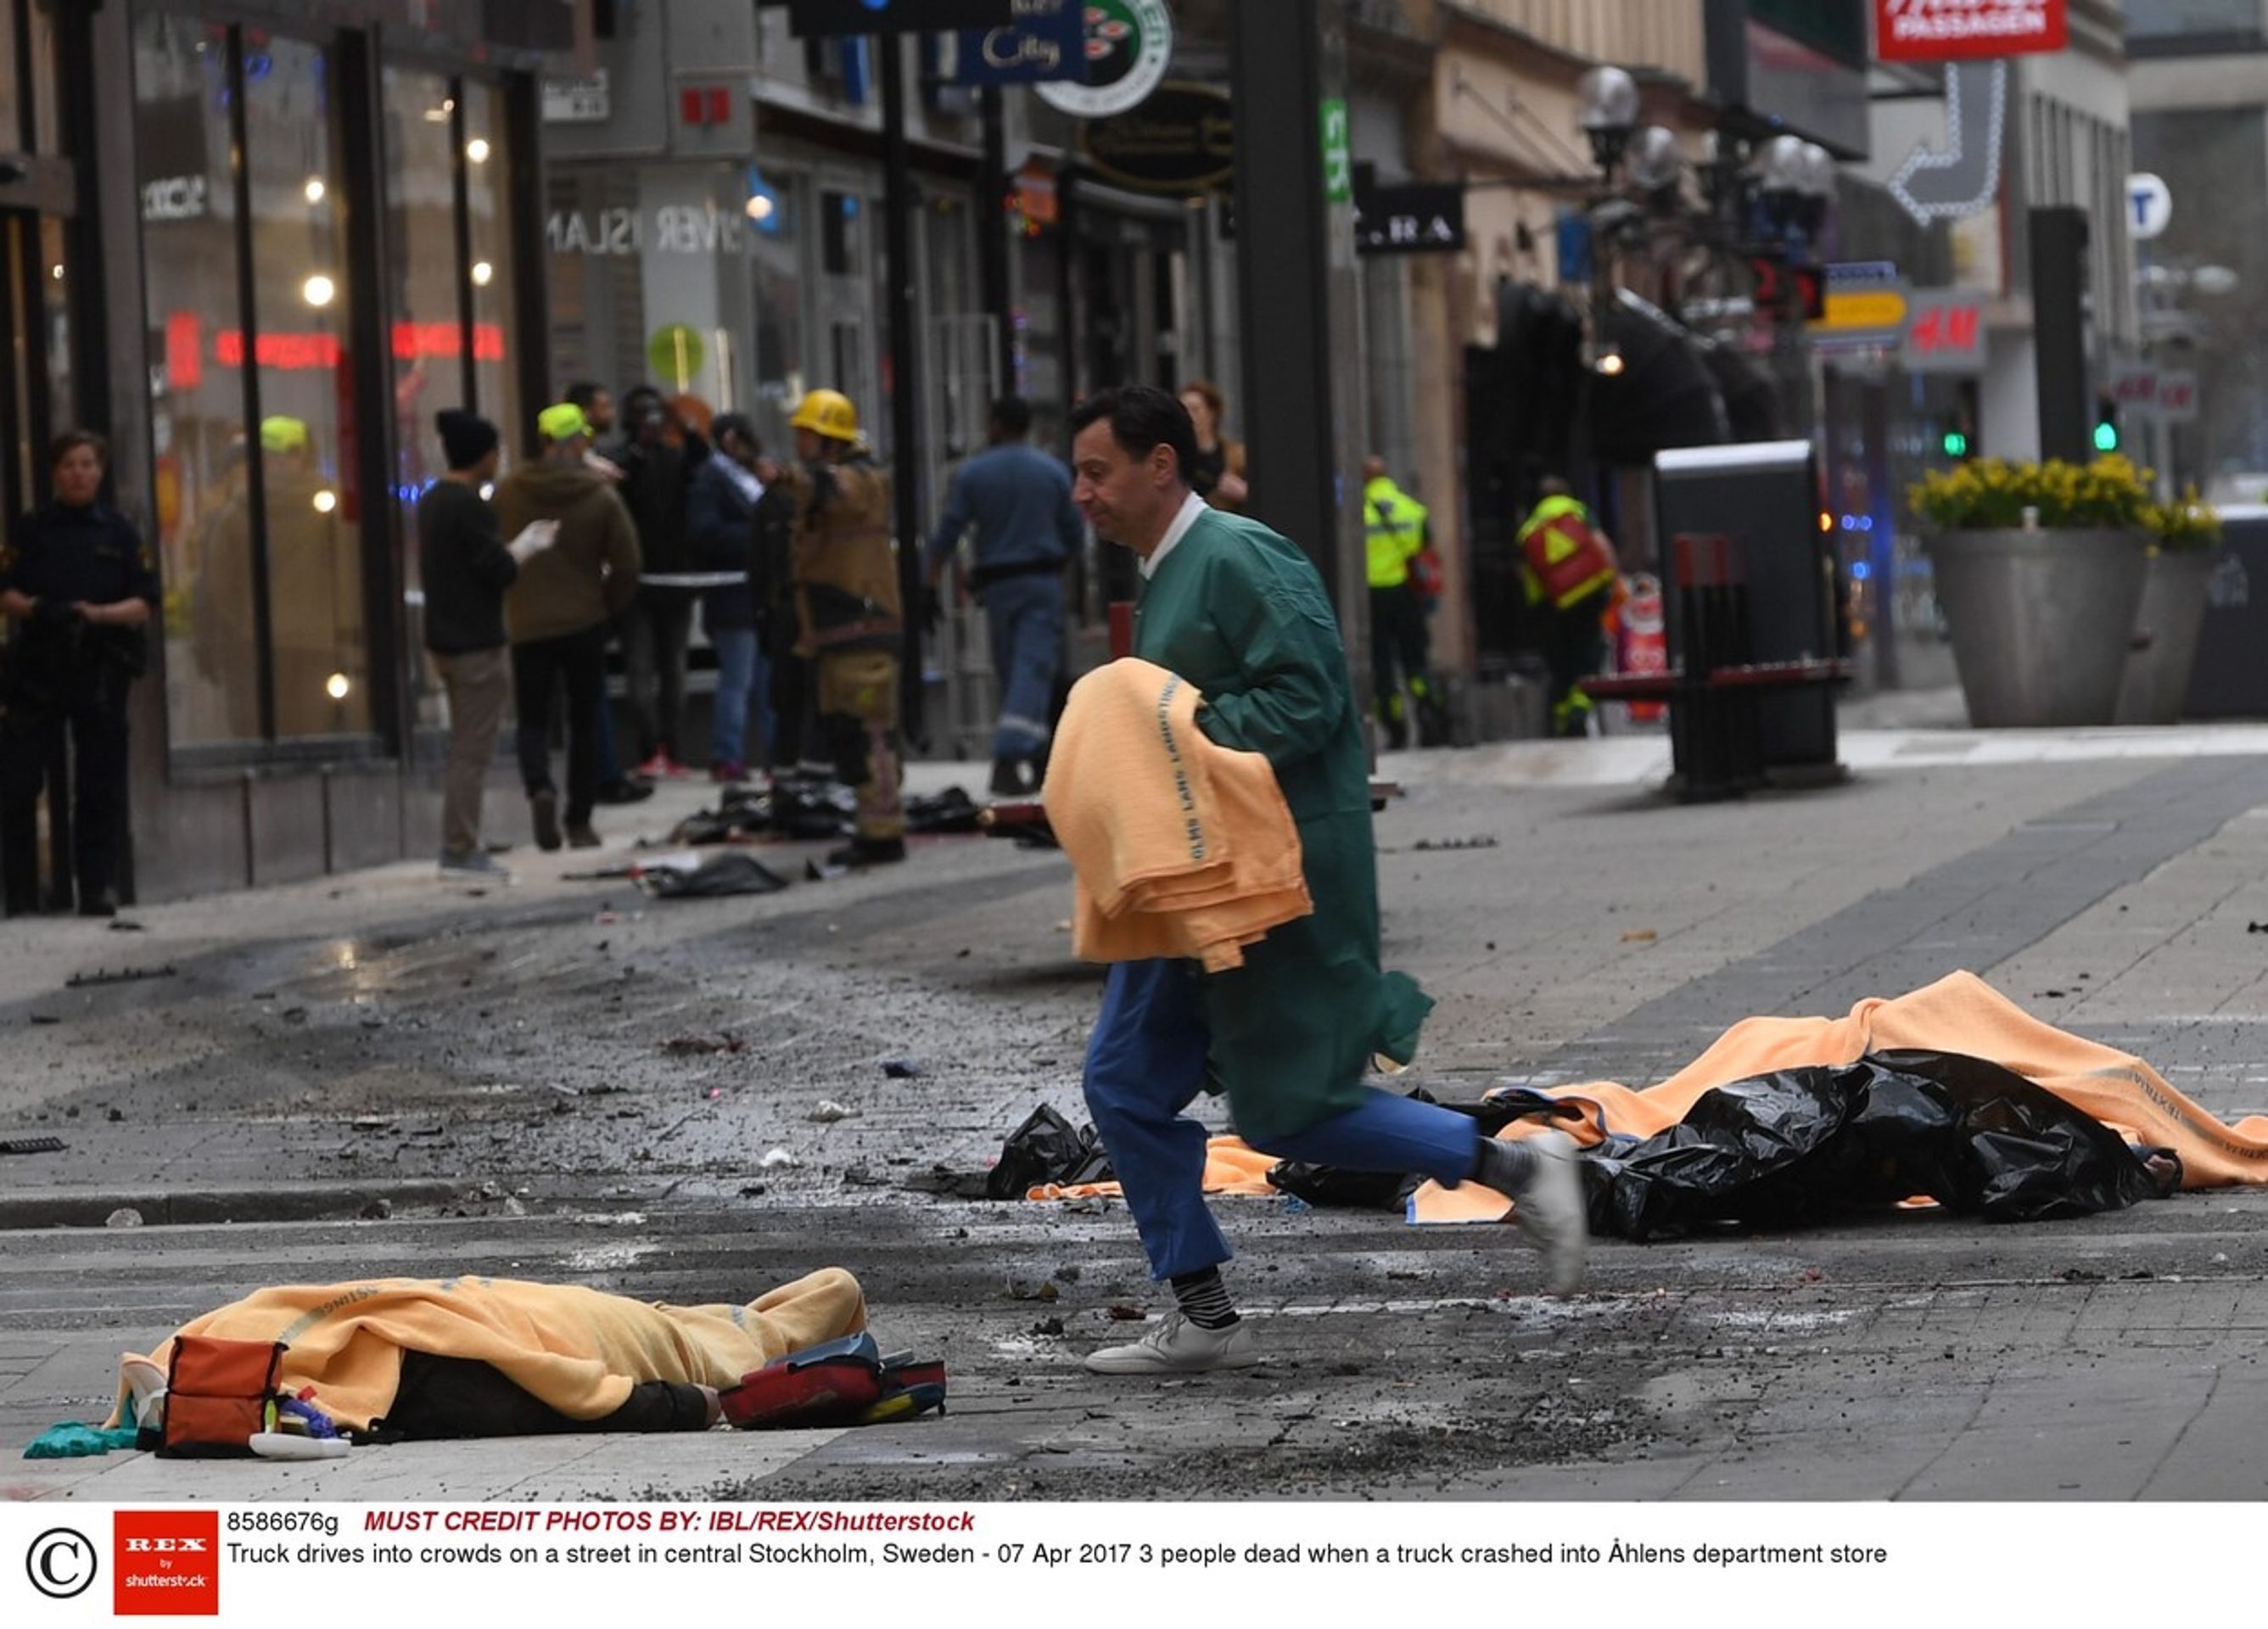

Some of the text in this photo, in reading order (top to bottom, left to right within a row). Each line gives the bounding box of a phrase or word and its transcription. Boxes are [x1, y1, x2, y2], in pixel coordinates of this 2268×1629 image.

[1893, 12, 2047, 40] PASSAGEN
[982, 25, 1060, 71] City
[2129, 192, 2154, 225] T
